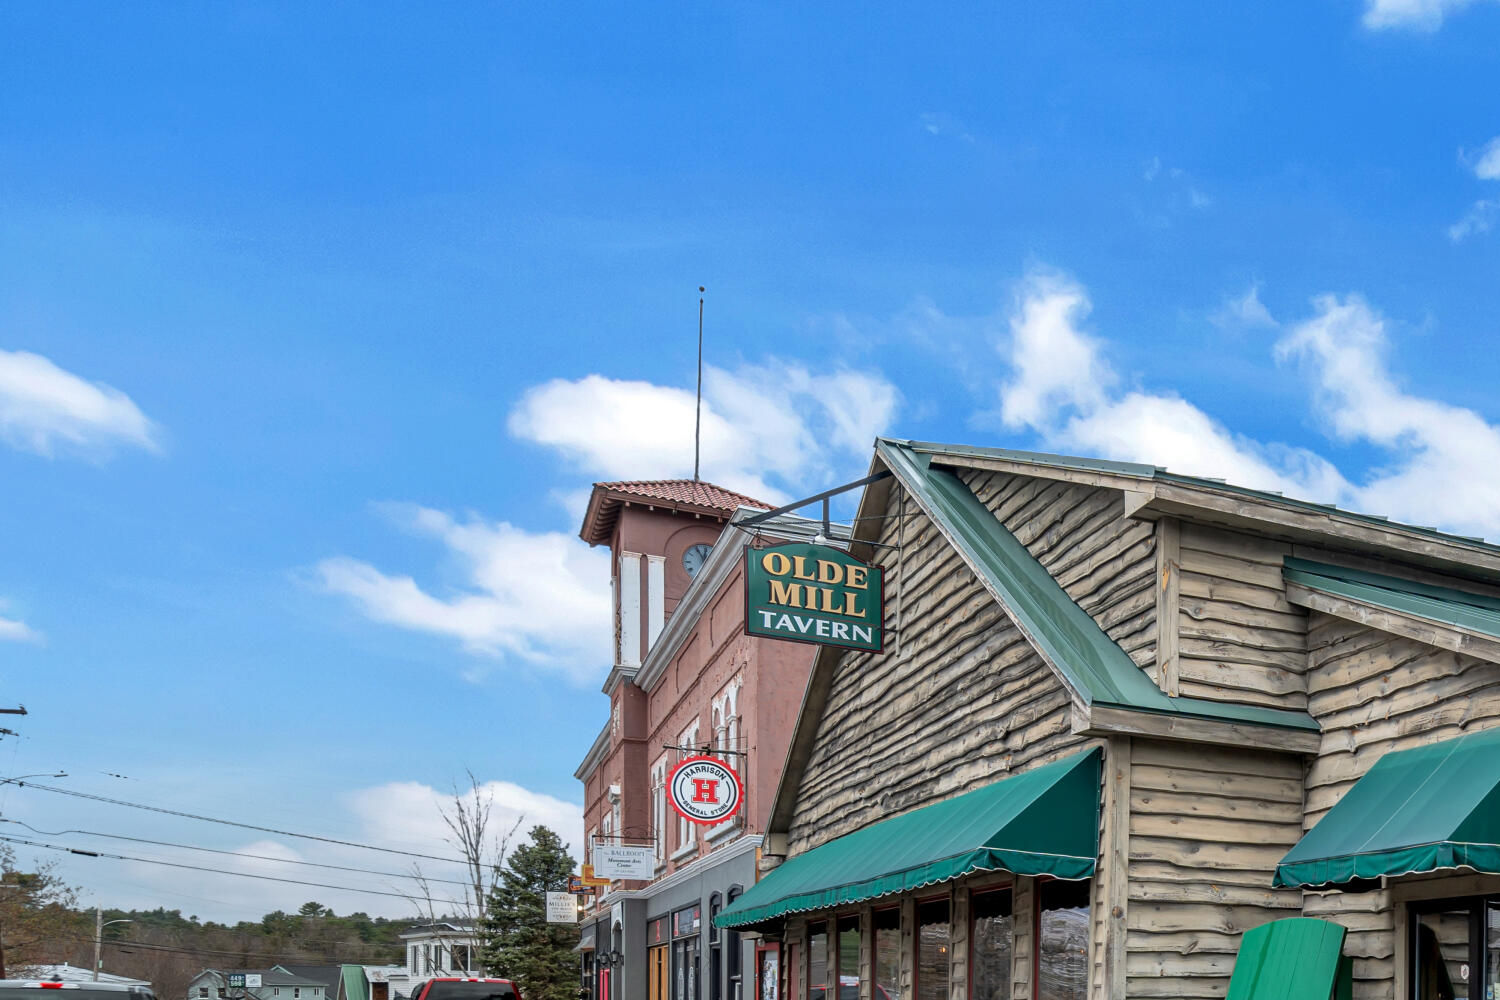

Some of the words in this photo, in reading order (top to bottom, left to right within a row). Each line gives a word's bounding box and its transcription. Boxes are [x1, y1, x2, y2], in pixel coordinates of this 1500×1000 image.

[762, 552, 868, 590] OLDE
[768, 580, 866, 618] MILL
[758, 610, 872, 643] TAVERN
[683, 765, 727, 781] HARRISON
[691, 778, 720, 804] H
[683, 800, 708, 816] GENERAL
[710, 803, 729, 816] STORE
